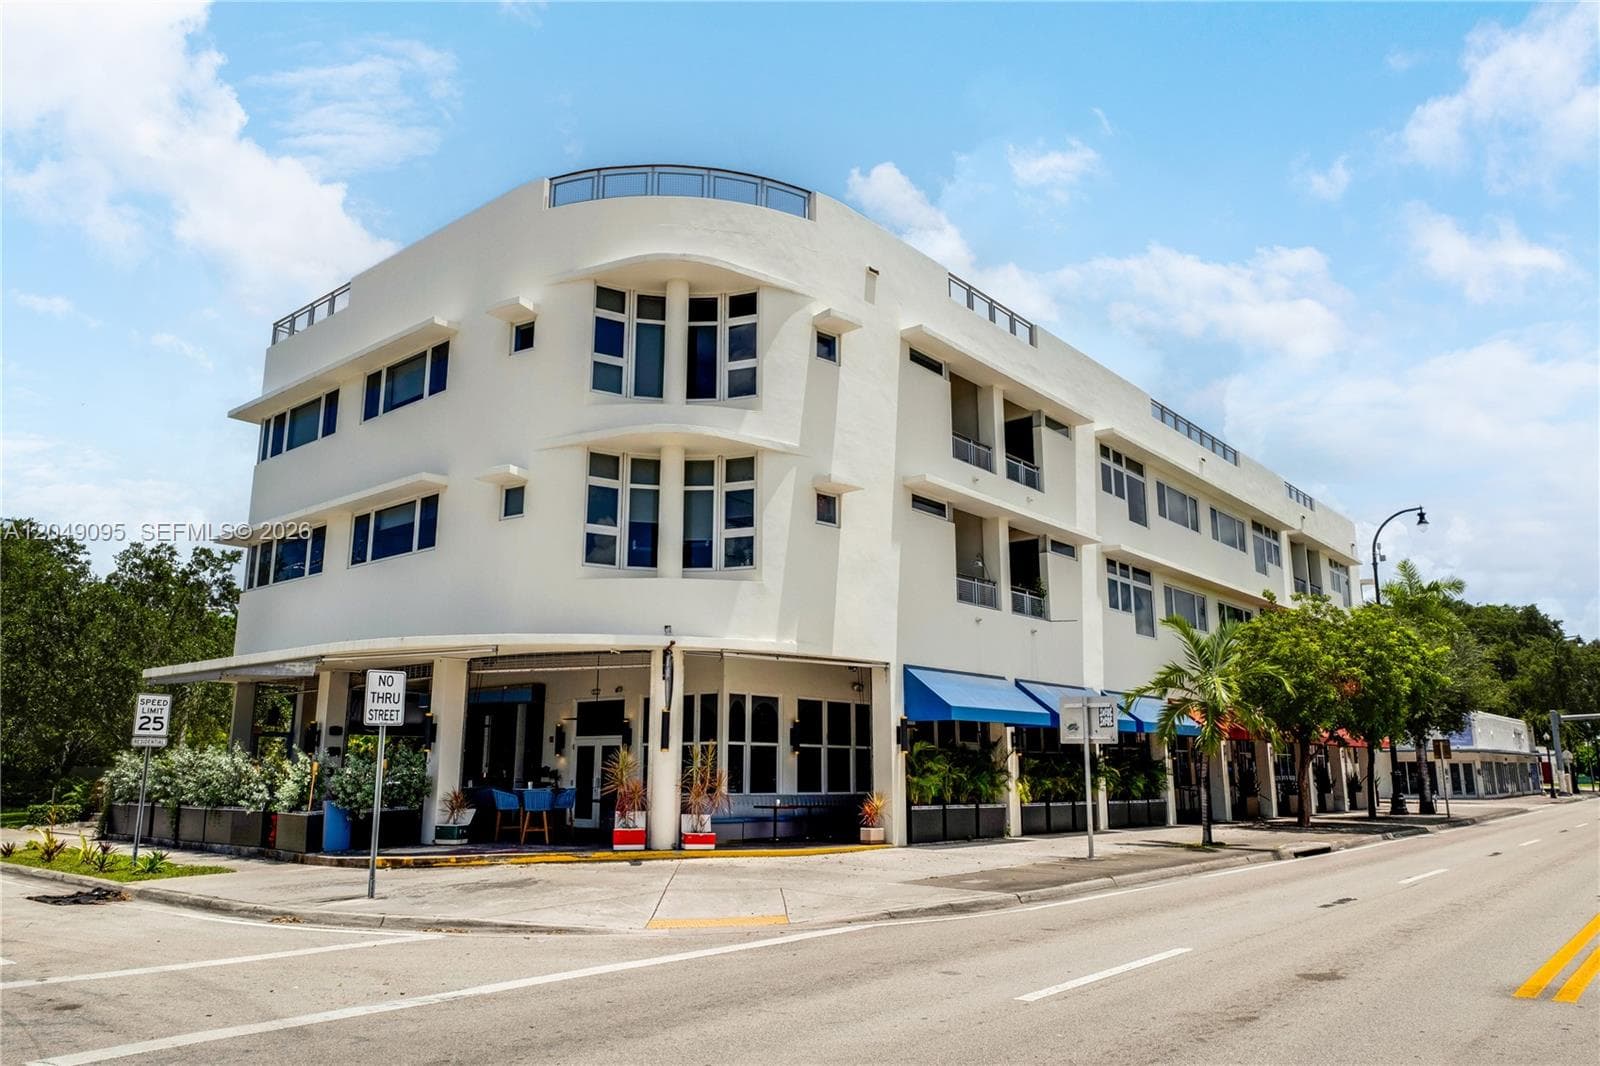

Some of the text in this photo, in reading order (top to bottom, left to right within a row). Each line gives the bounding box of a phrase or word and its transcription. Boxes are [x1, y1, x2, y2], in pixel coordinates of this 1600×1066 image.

[378, 675, 394, 687] NO
[140, 698, 169, 706] SPEED
[370, 691, 401, 704] THRU
[368, 709, 400, 721] STREET
[138, 716, 164, 731] 25
